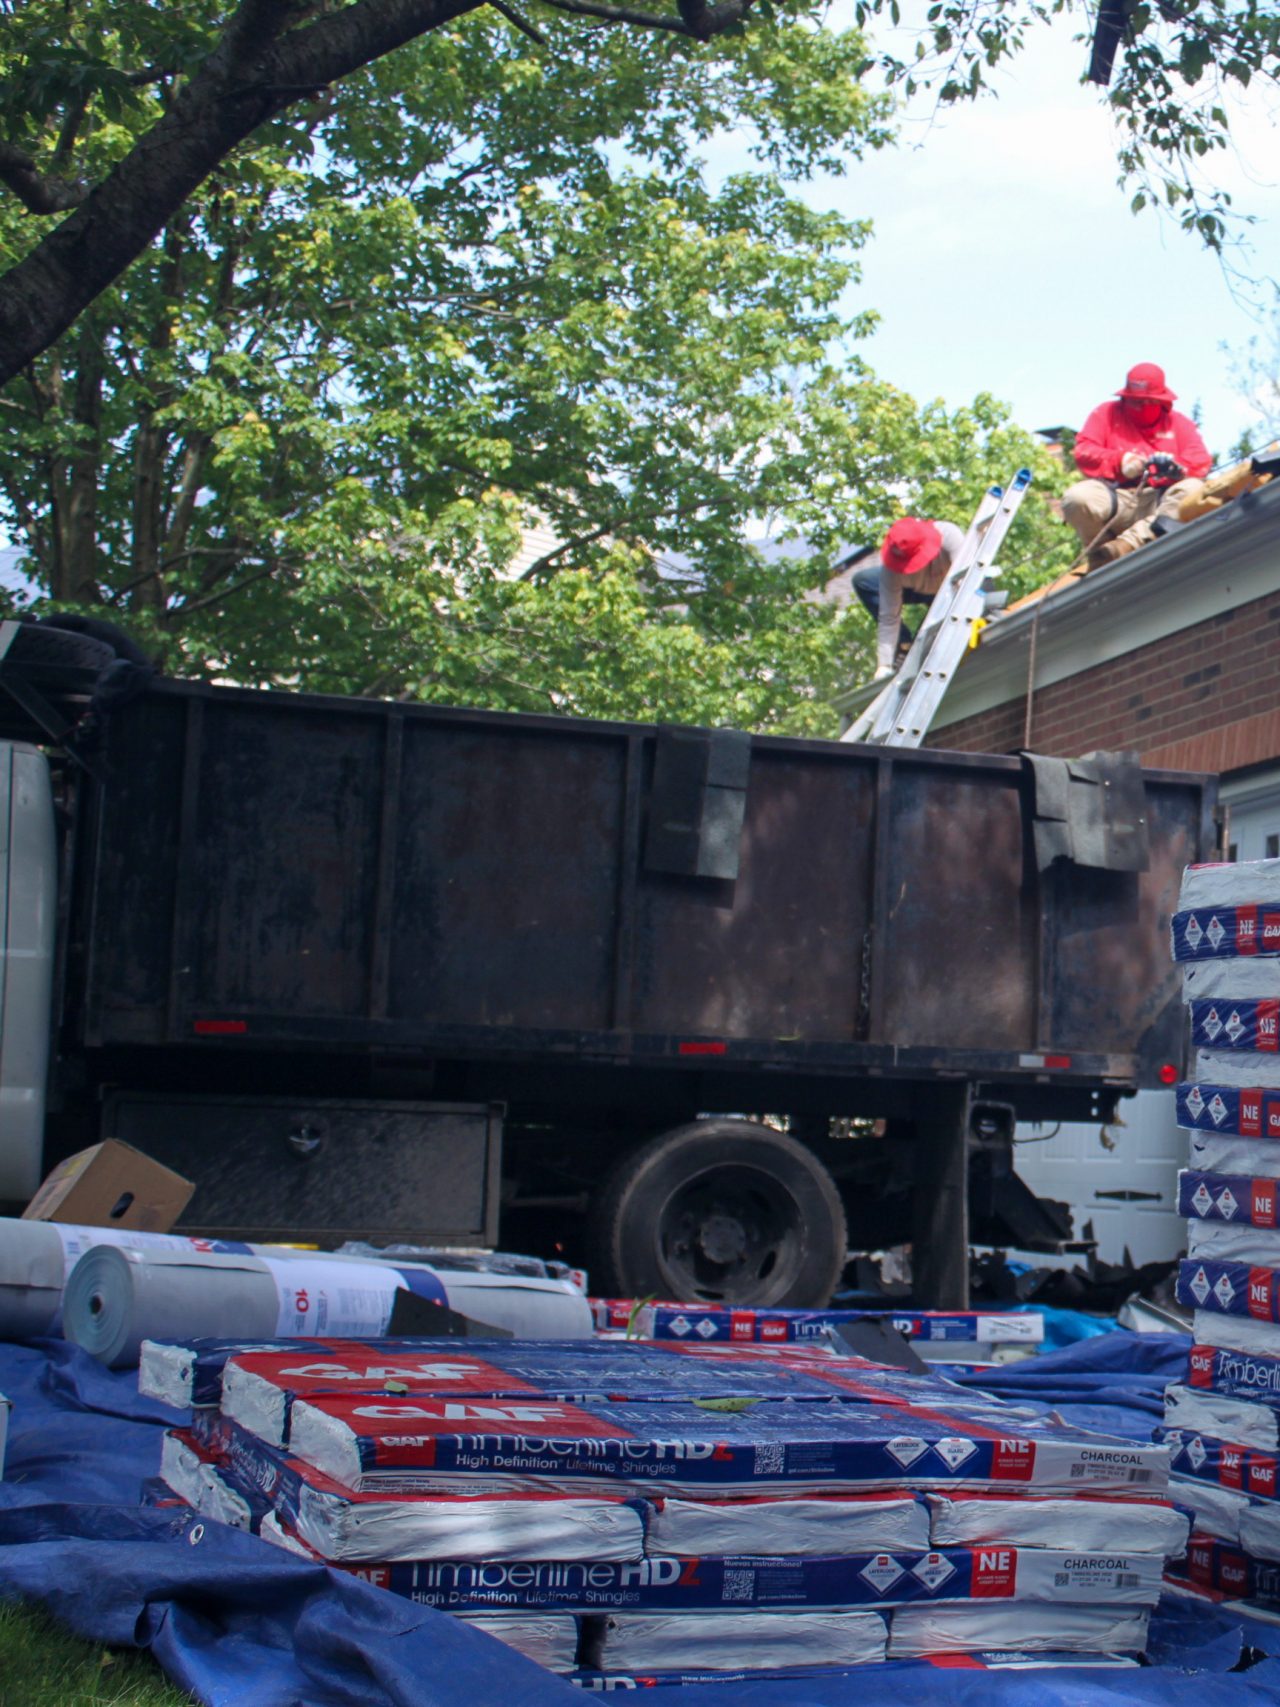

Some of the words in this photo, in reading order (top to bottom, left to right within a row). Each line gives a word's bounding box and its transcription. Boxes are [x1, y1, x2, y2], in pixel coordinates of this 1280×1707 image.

[1240, 920, 1254, 934] NE
[1260, 1018, 1276, 1034] NE
[1243, 1105, 1258, 1119] NE
[1255, 1197, 1271, 1213] NE
[1251, 1285, 1267, 1302] NE
[735, 1324, 751, 1332] NE
[278, 1363, 479, 1379] GAF
[1192, 1356, 1210, 1371] GAF
[352, 1403, 565, 1422] GAF
[1001, 1440, 1029, 1453] NE
[456, 1455, 489, 1467] High
[494, 1455, 557, 1469] Definition
[567, 1459, 615, 1472] Lifetime
[623, 1462, 676, 1474] Shingles
[1081, 1451, 1143, 1464] CHARCOAL
[1223, 1451, 1240, 1468] NE
[1252, 1466, 1273, 1482] GAF
[980, 1552, 1009, 1571] NE
[1064, 1559, 1129, 1569] CHARCOAL
[1193, 1552, 1209, 1567] NE
[1222, 1567, 1244, 1582] GAF
[411, 1591, 444, 1606] High
[449, 1591, 516, 1603] Definition
[527, 1591, 578, 1602] Lifetime
[585, 1590, 640, 1605] Shingles
